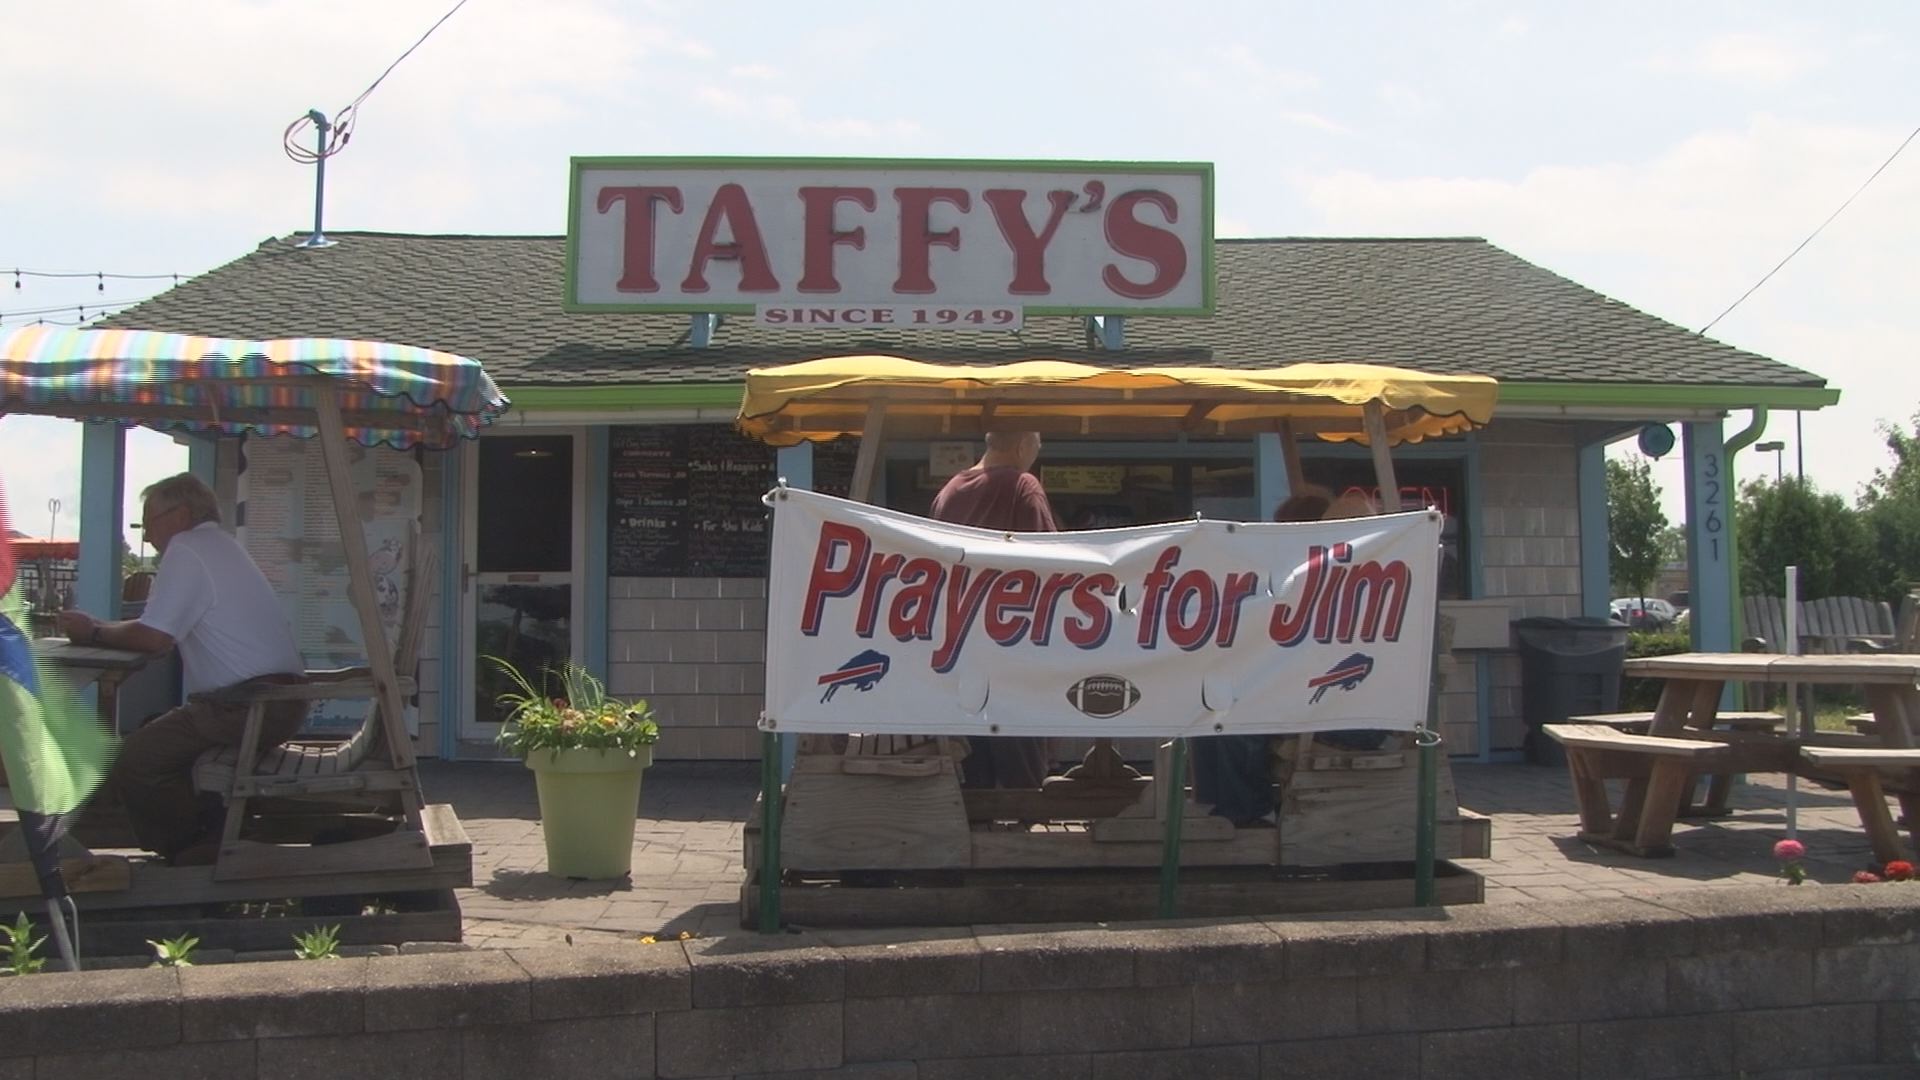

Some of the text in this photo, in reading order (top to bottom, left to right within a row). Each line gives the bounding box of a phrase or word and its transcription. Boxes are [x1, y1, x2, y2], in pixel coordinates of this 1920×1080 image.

[596, 179, 1188, 299] TAFFY'S
[764, 307, 1017, 325] SINCE 1949
[1340, 486, 1448, 519] OEN
[1704, 454, 1722, 561] 3261
[800, 520, 1119, 673] Prayers
[1134, 545, 1258, 651] for
[1268, 541, 1413, 647] Jim
